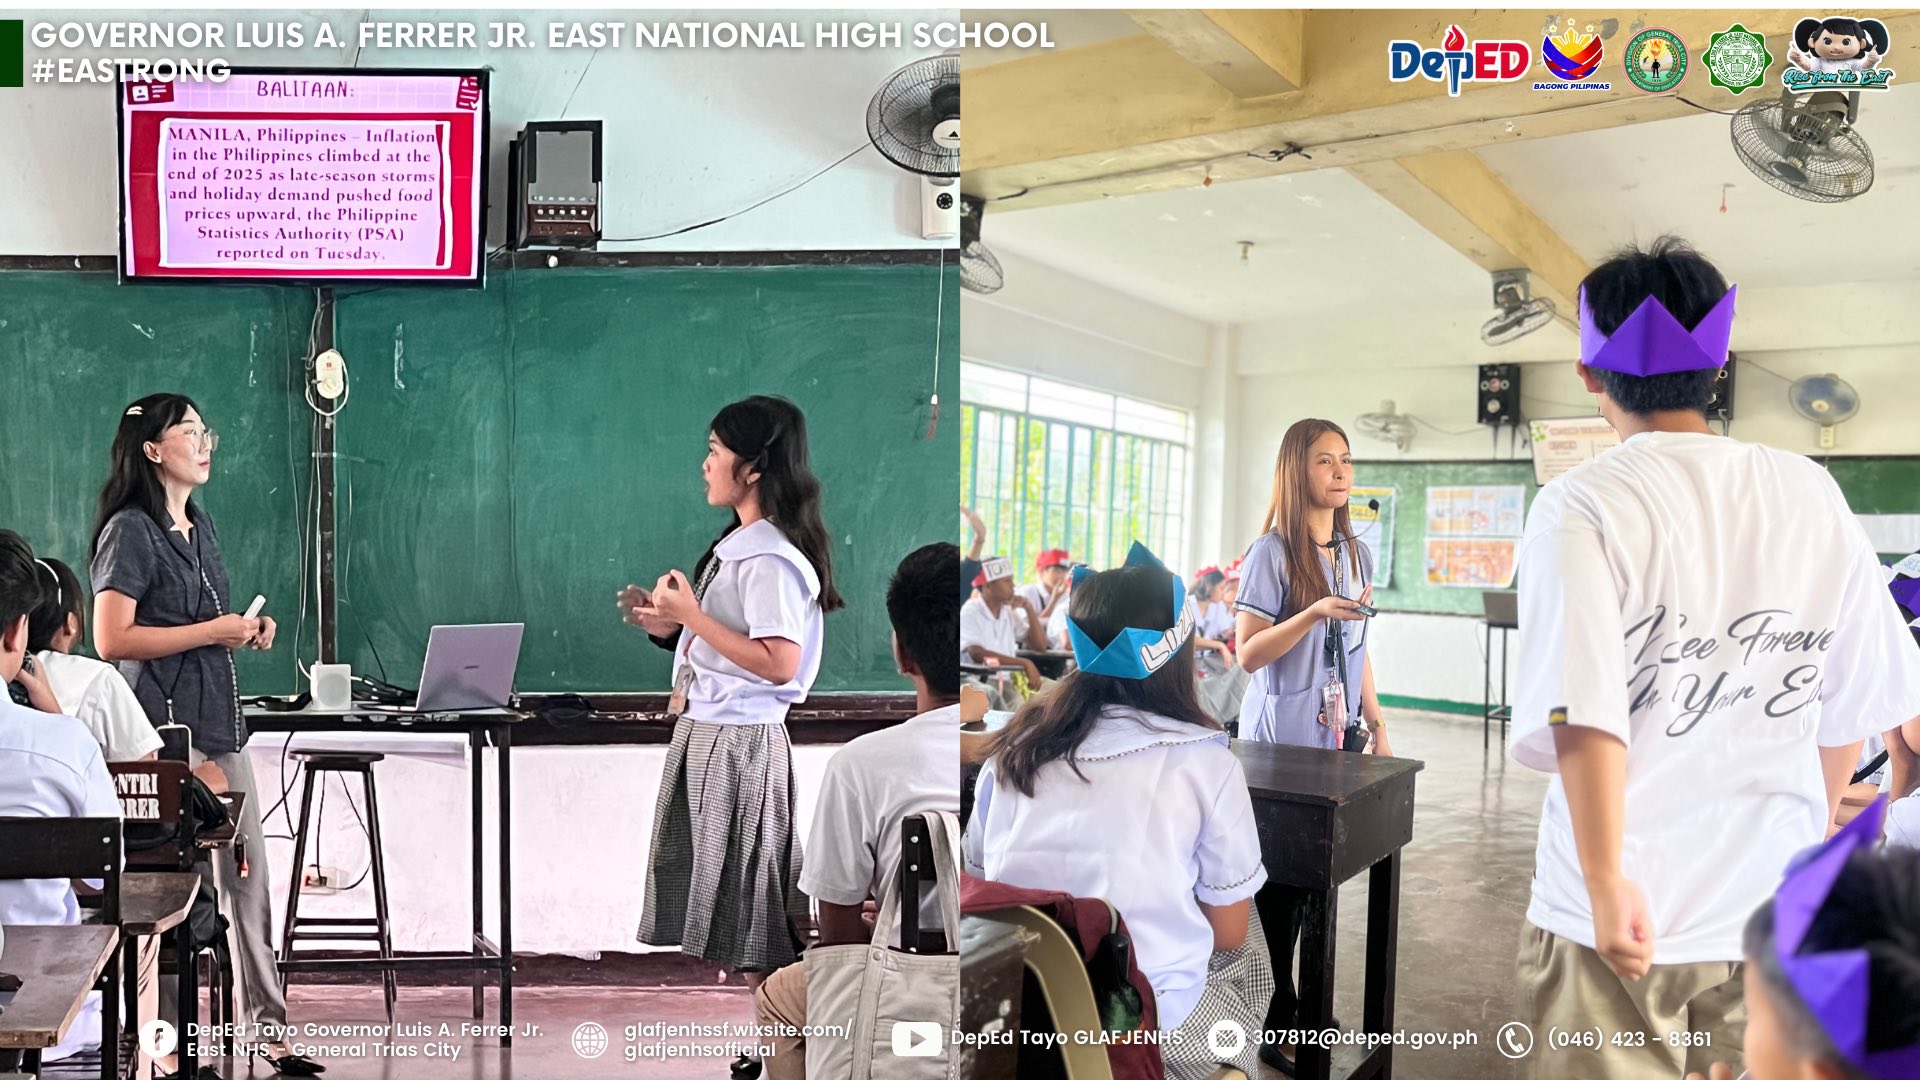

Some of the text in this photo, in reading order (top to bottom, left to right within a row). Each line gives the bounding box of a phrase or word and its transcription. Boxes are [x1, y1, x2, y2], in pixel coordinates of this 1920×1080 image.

[257, 80, 354, 99] BALITAAN:
[168, 127, 251, 143] MANILA,
[257, 128, 347, 145] Philippines
[366, 129, 435, 143] Inflation
[172, 147, 431, 164] in the Philippines climbed at the
[167, 166, 436, 183] end of 2025 as late-season storms
[169, 186, 433, 204] and holiday demand pushed food
[184, 207, 419, 224] prices upward, the Philippine
[197, 226, 404, 243] Statistics Authority (PSA)
[217, 246, 386, 263] reported on Tuesday.
